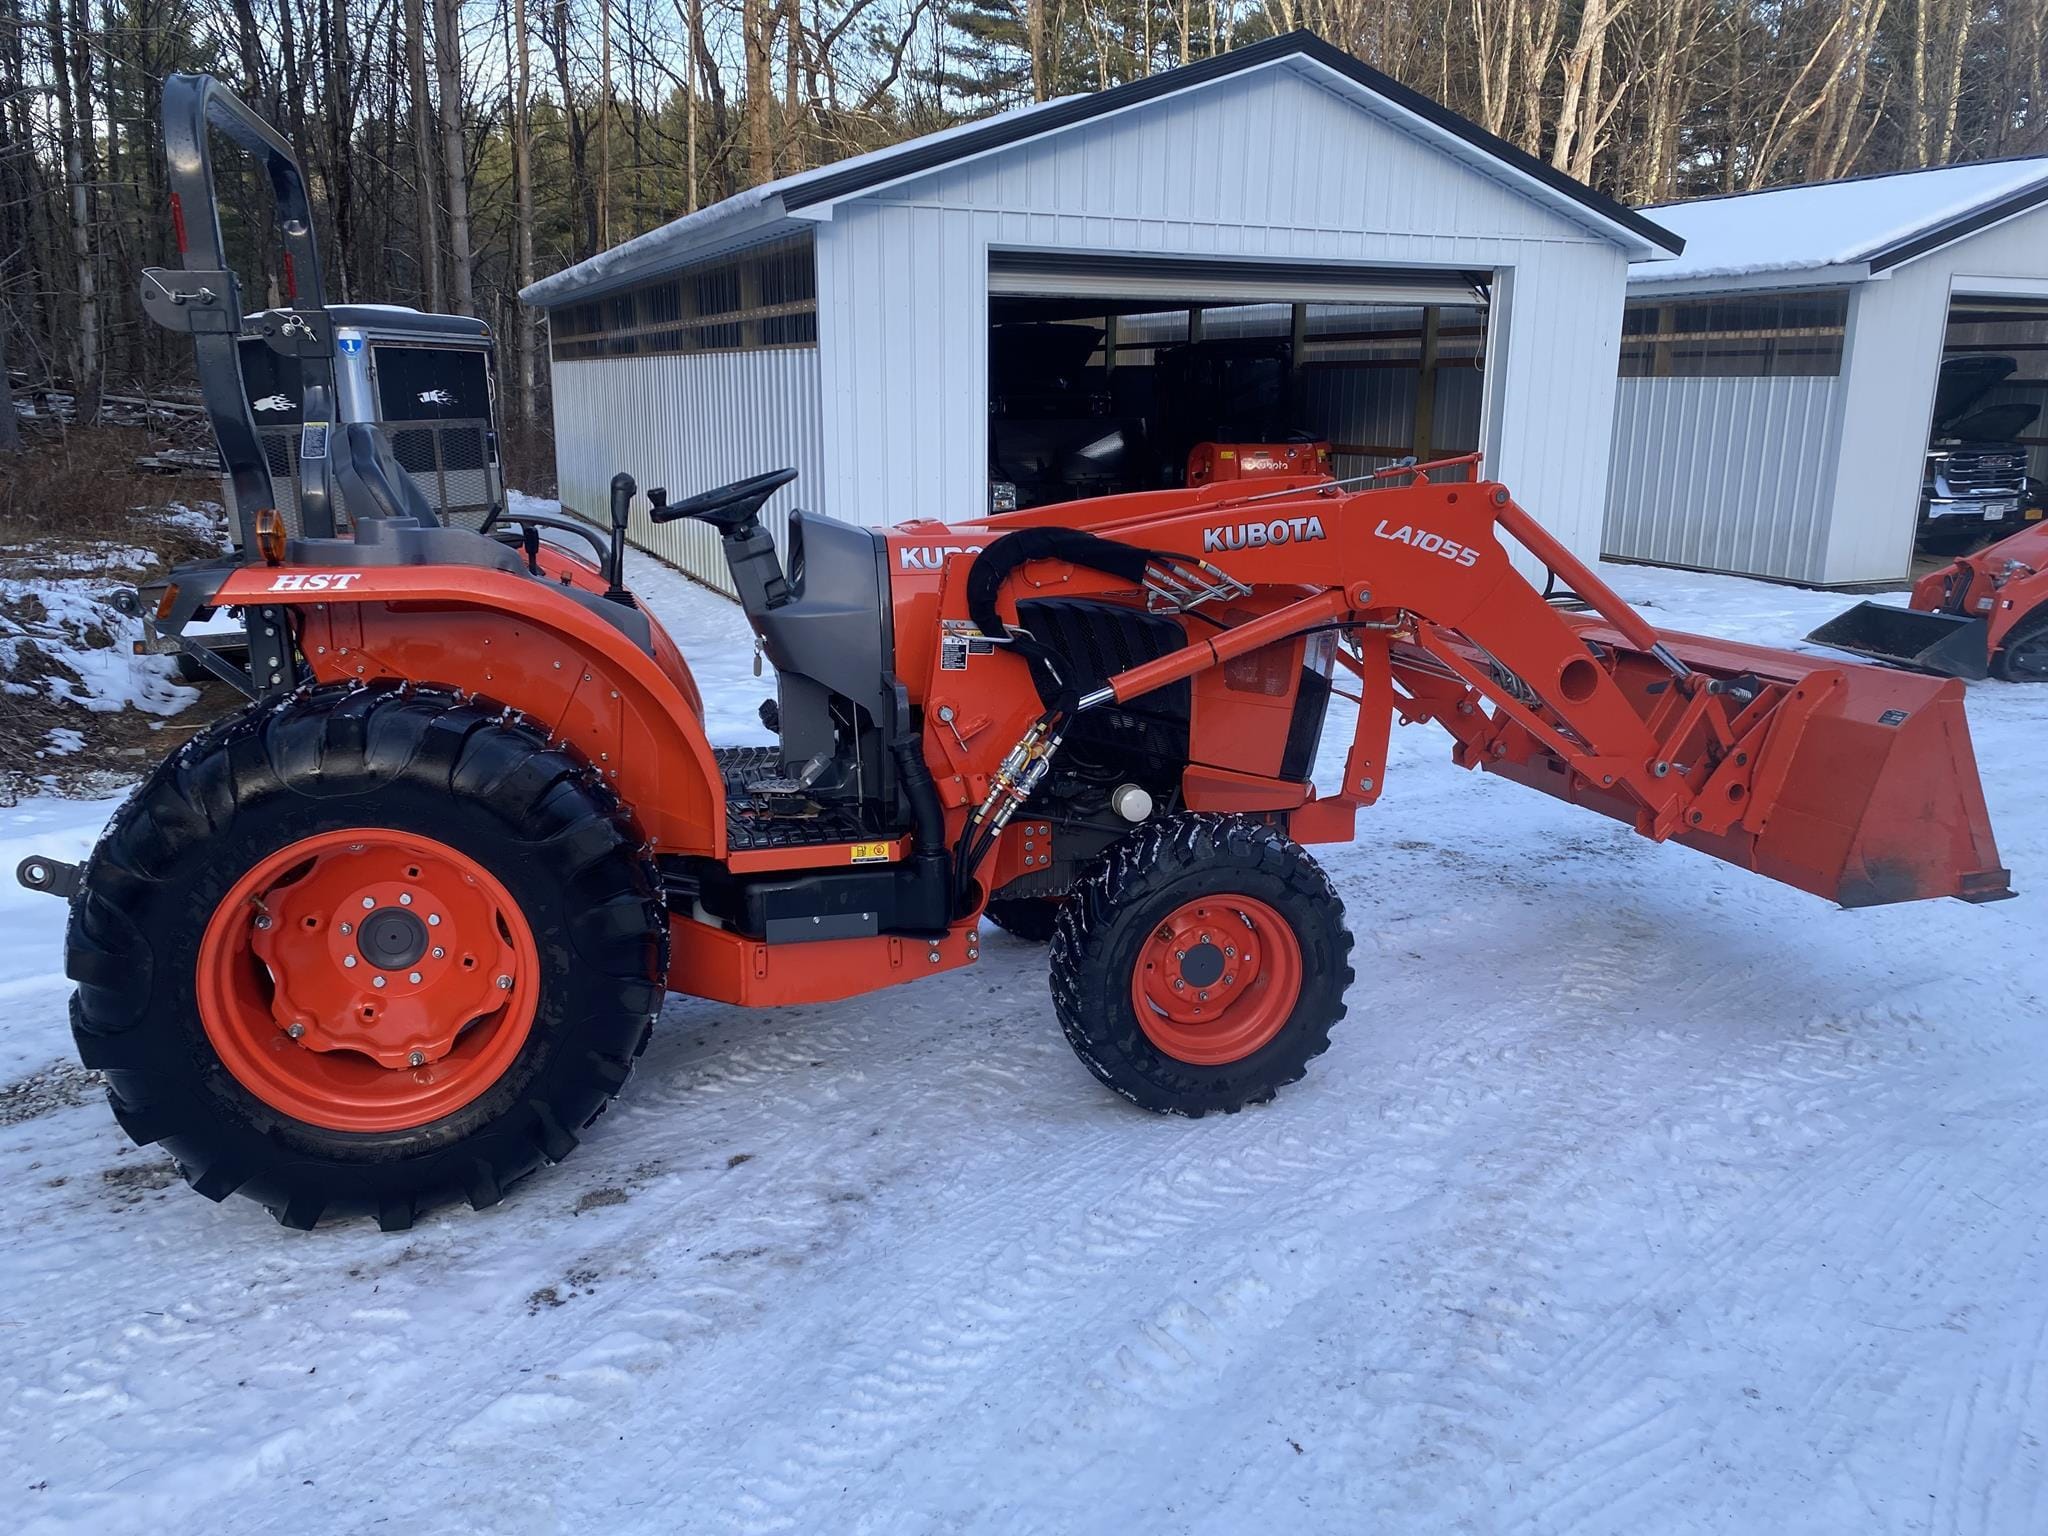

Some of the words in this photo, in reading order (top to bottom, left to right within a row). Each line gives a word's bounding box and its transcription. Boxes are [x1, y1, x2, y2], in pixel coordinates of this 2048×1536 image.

[1203, 516, 1326, 553] KUBOTA
[1374, 519, 1480, 567] LA1055
[267, 573, 362, 591] HST
